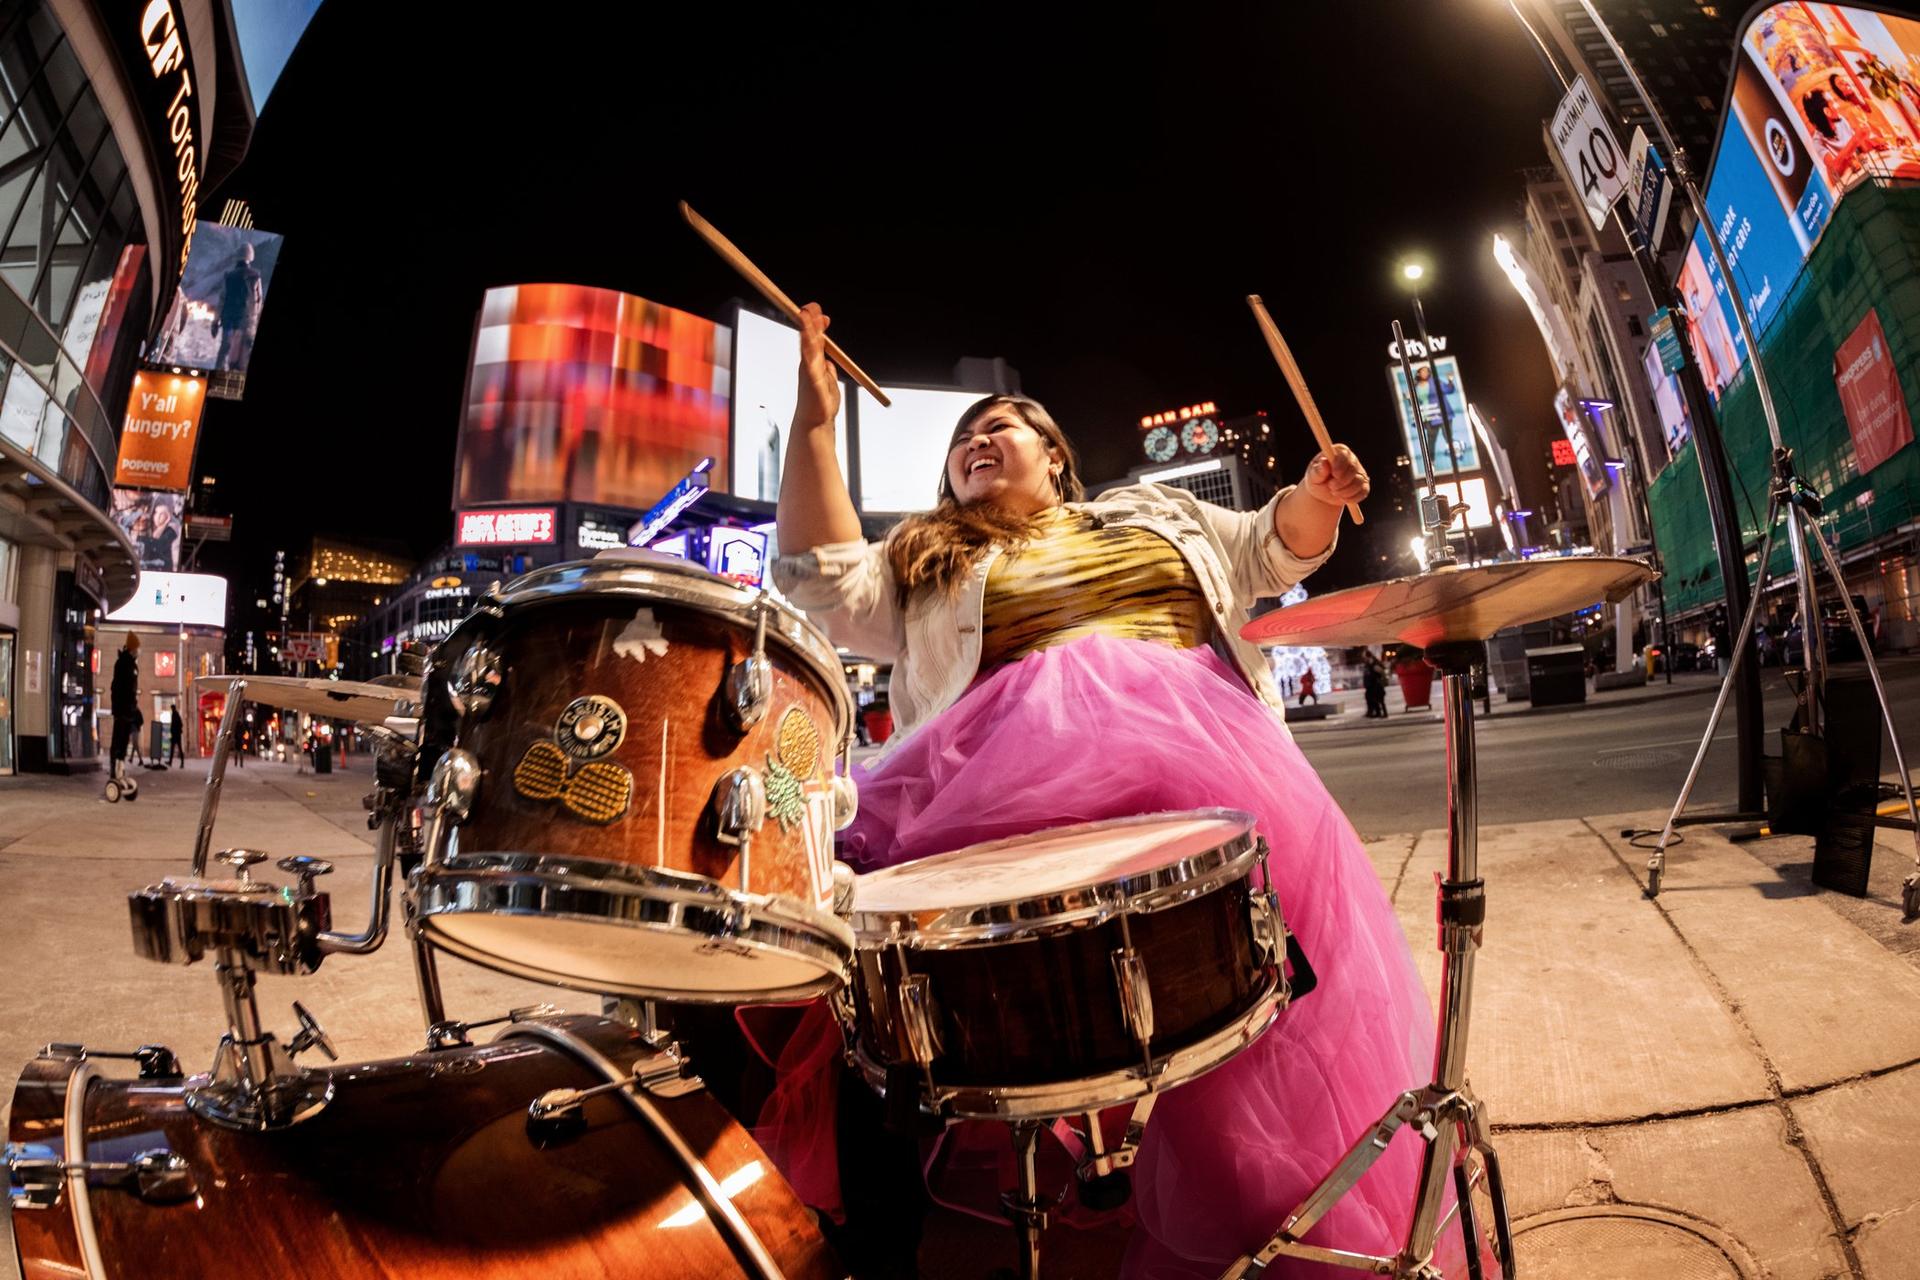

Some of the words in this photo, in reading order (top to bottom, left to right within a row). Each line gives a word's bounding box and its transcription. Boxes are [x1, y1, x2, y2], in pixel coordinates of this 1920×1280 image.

[141, 0, 185, 78] CF
[166, 68, 198, 235] Toronto
[1558, 89, 1591, 149] MAXIMUM
[1579, 127, 1617, 197] 40
[1715, 277, 1725, 297] IN
[1735, 216, 1752, 251] GRIS
[1719, 204, 1737, 245] WORK
[141, 392, 178, 413] Y'all
